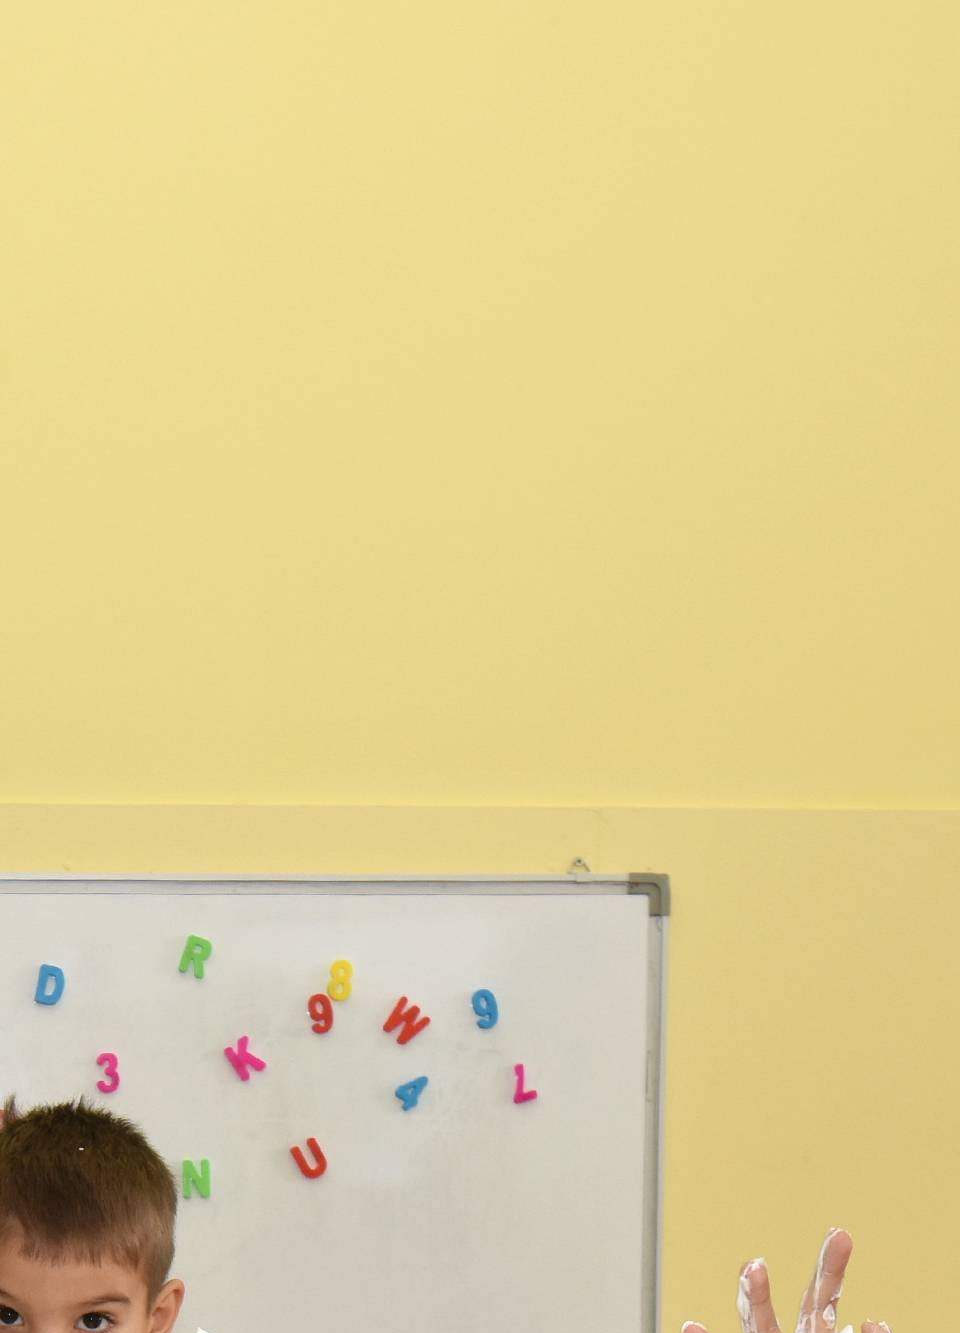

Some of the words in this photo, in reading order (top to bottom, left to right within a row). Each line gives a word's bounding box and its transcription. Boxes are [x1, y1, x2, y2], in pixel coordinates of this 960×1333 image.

[180, 935, 212, 978] R
[34, 964, 65, 1005] D
[327, 960, 353, 1002] 8
[307, 994, 334, 1034] 9
[383, 996, 431, 1045] W
[472, 989, 499, 1029] 9
[96, 1053, 120, 1093] 3
[224, 1035, 266, 1081] K
[395, 1076, 428, 1110] 4
[513, 1064, 538, 1104] L
[290, 1137, 328, 1179] U
[182, 1159, 211, 1198] N
